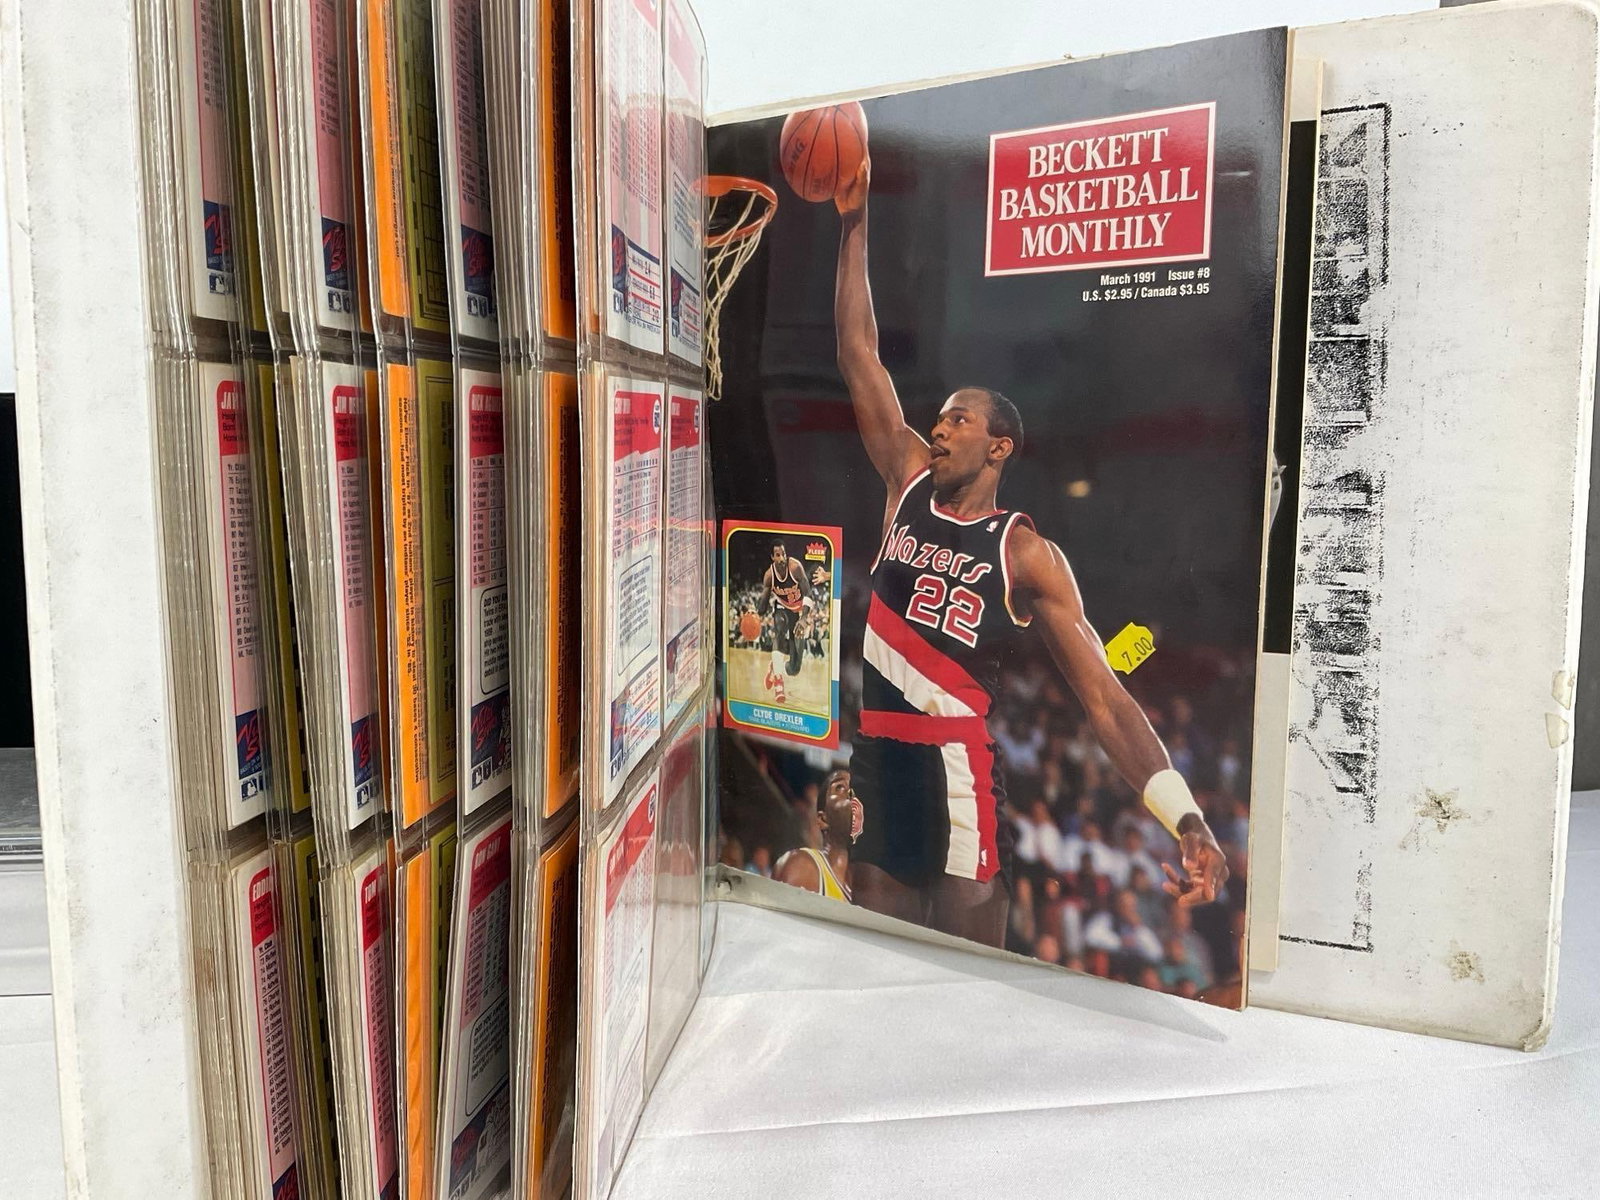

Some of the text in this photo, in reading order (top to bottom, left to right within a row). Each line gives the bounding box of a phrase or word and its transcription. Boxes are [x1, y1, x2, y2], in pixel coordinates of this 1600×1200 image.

[1028, 128, 1168, 178] BECKETT
[999, 167, 1199, 221] BASKETBALL
[1020, 213, 1172, 258] MONTHLY
[1082, 283, 1210, 302] U.S. $2.95 / Canada $3.95
[1100, 267, 1211, 286] March 1991 Issue #8
[905, 573, 985, 649] 22
[1121, 637, 1153, 667] 7.00
[753, 708, 773, 720] CLYDE
[774, 711, 803, 726] DREXLER
